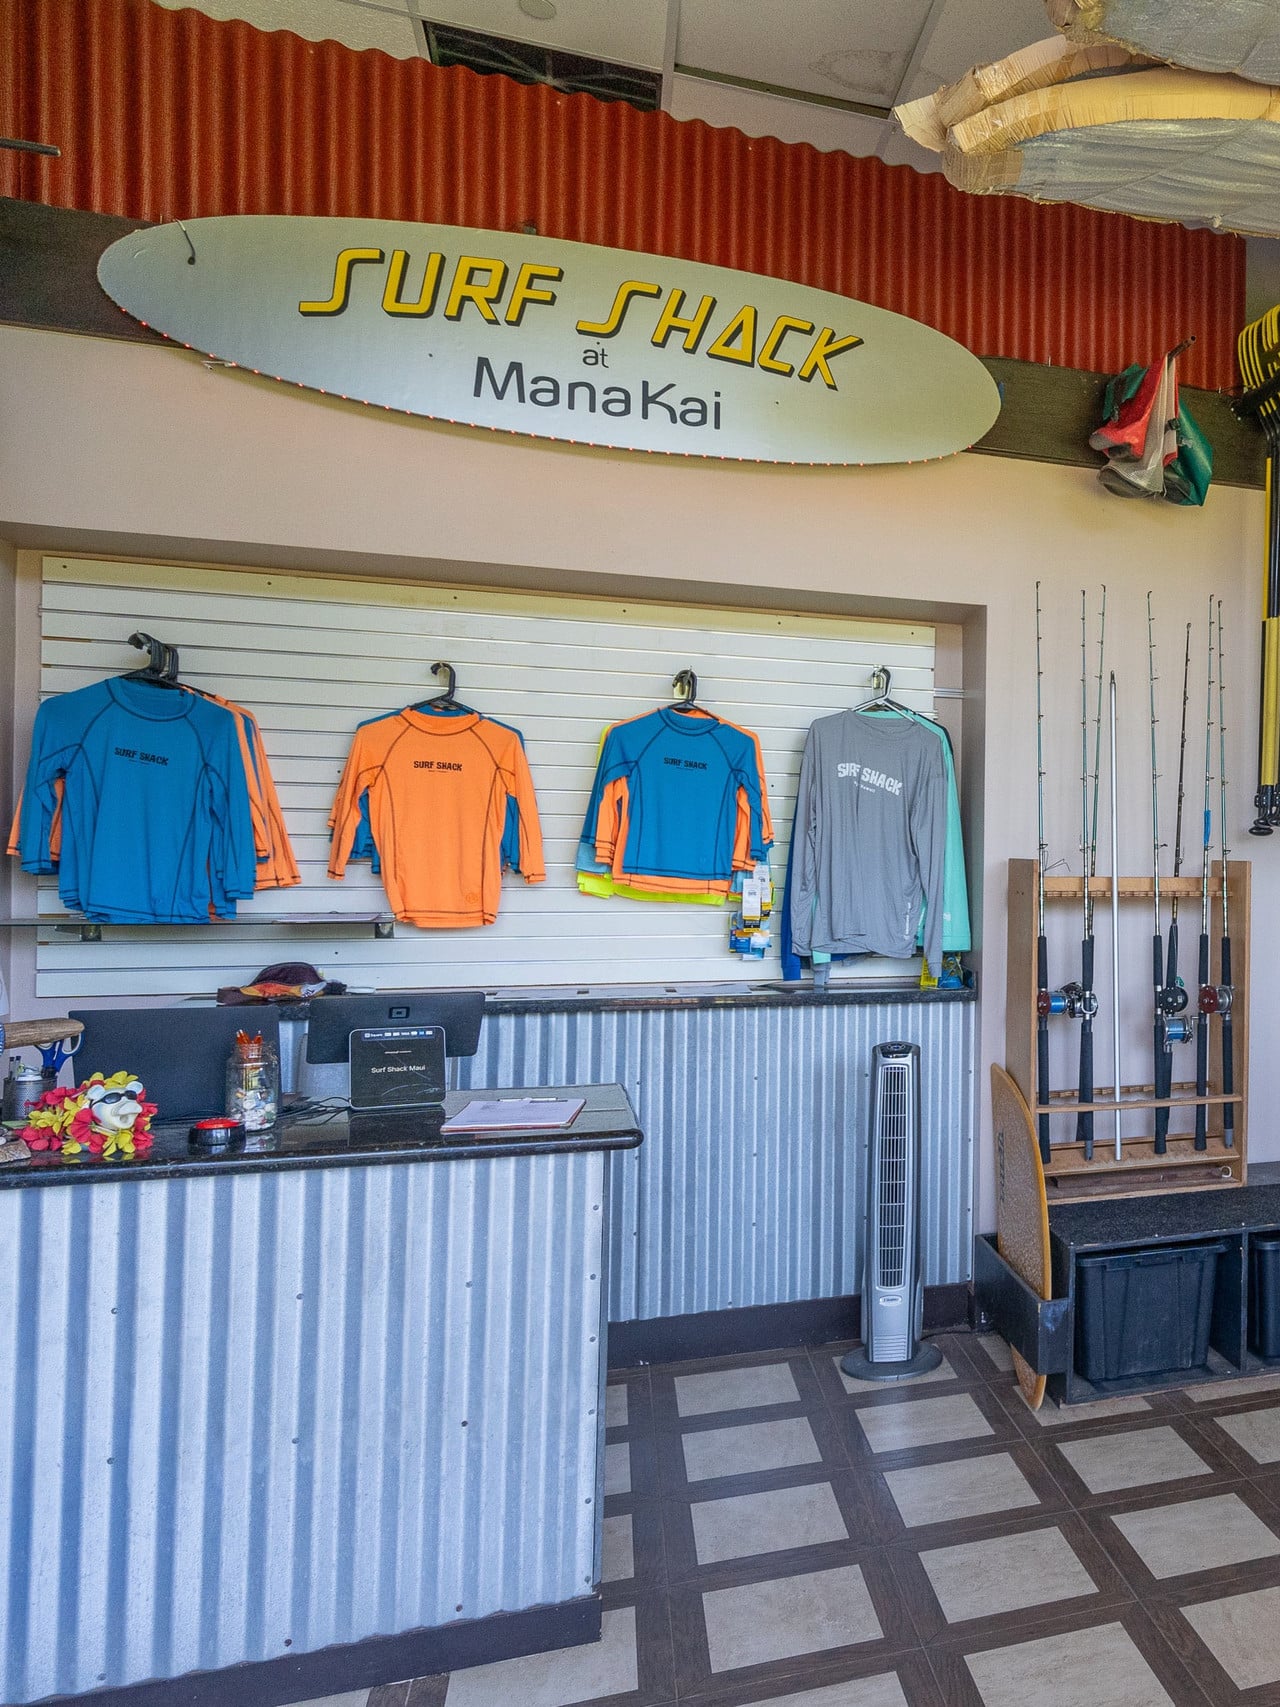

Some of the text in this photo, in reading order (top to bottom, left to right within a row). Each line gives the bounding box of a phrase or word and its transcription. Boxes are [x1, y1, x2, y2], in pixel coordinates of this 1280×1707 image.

[298, 248, 864, 391] SURF SHACK
[582, 347, 610, 368] at
[473, 356, 721, 430] ManaKai
[114, 747, 137, 758] SURF
[139, 752, 169, 766] SHACK
[413, 760, 463, 772] SURF SHACK
[663, 757, 682, 766] SURF
[684, 760, 708, 770] SHACK
[861, 767, 903, 796] SHACK
[387, 1065, 408, 1073] Shack
